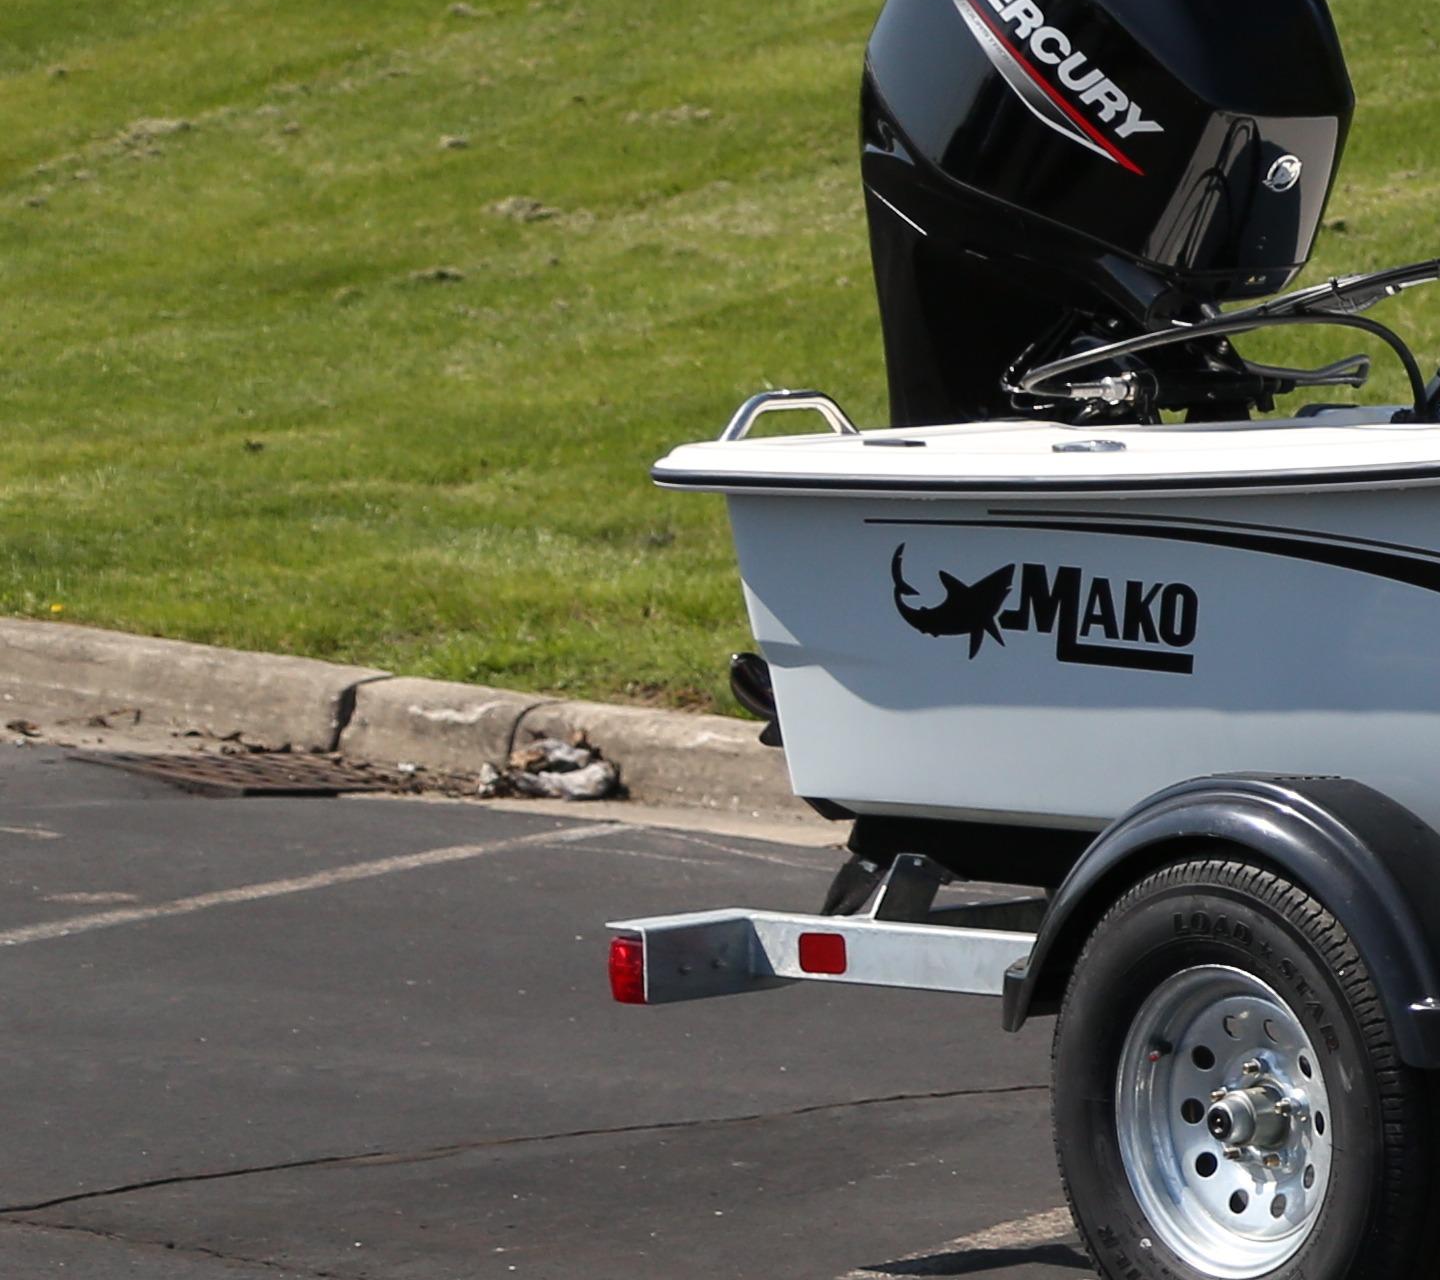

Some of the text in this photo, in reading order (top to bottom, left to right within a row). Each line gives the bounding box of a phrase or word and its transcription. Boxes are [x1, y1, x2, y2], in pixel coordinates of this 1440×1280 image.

[998, 562, 1199, 675] MAKO
[1173, 910, 1341, 1055] LOAD STAR
